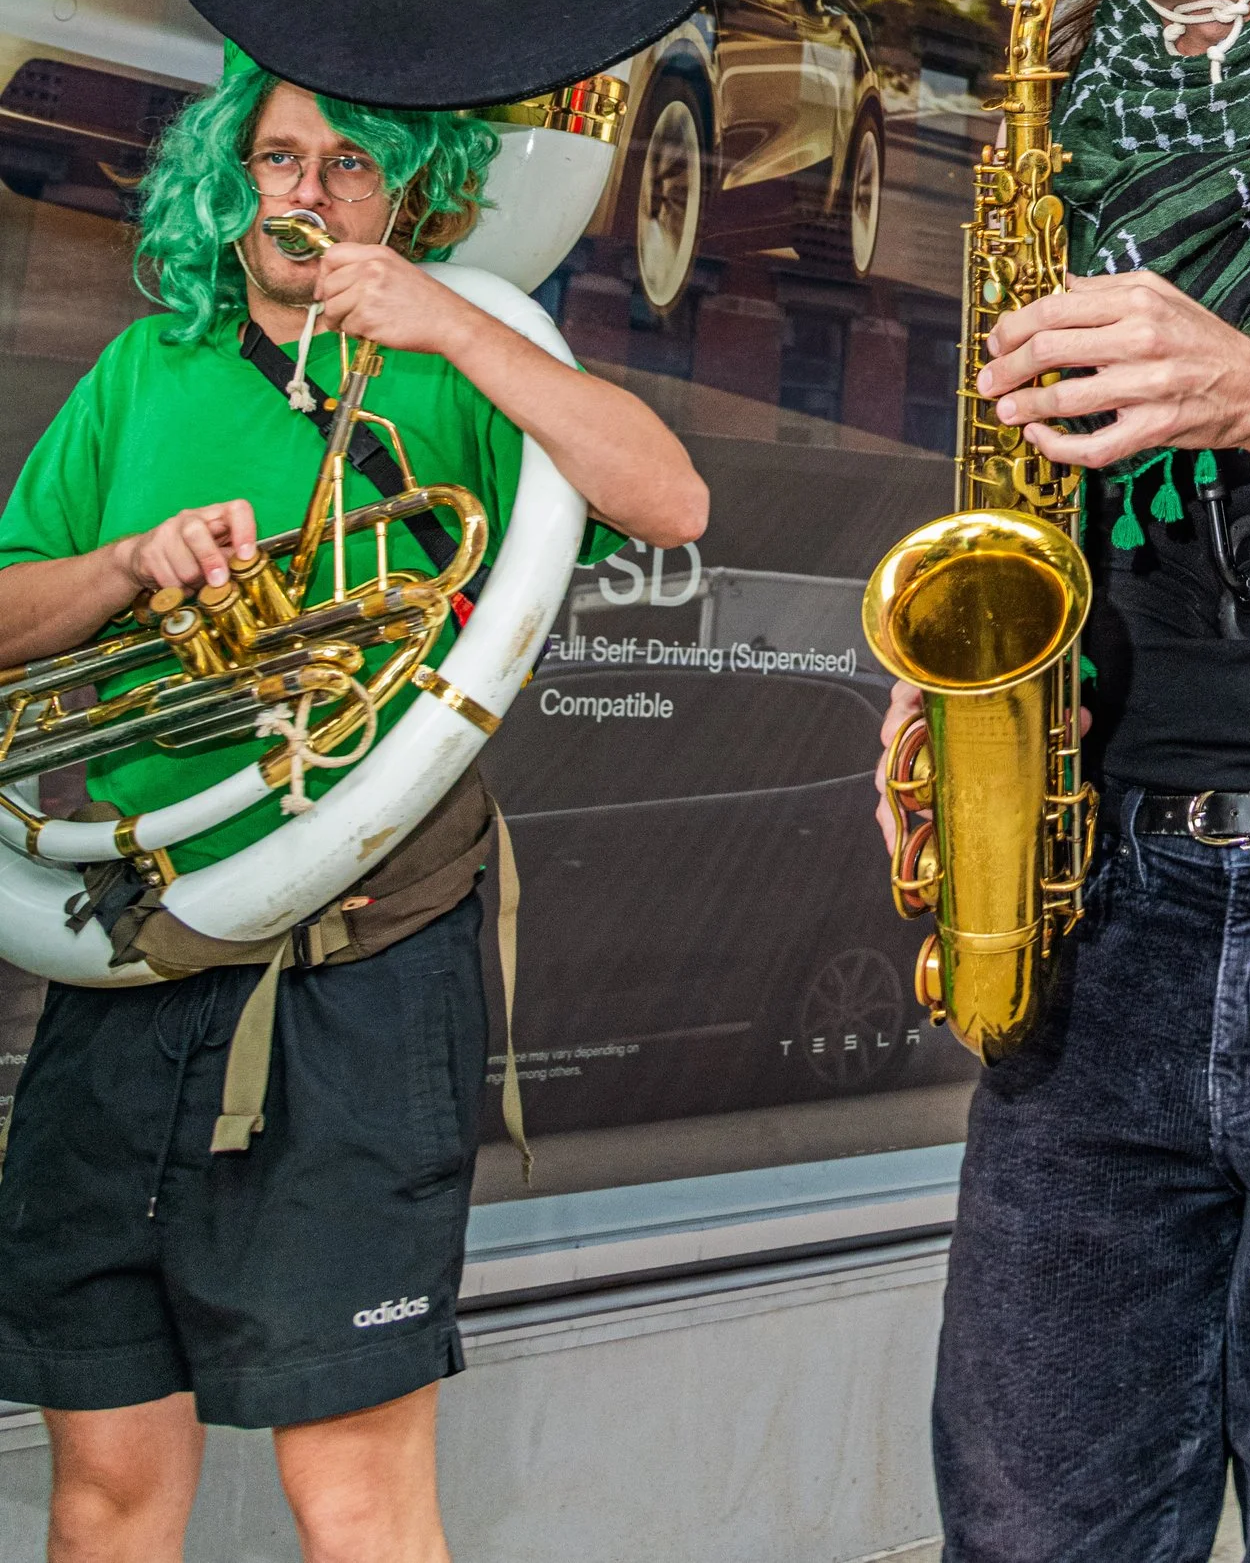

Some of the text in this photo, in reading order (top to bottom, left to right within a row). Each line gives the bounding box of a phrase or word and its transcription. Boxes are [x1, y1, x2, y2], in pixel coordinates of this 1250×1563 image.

[575, 536, 702, 607] SD
[592, 636, 723, 673] Self-Driving
[730, 642, 857, 676] (Supervised)
[540, 689, 674, 722] Compatible
[574, 1043, 625, 1058] depending
[626, 1043, 640, 1054] on
[780, 1029, 920, 1056] TESLA
[517, 1068, 547, 1082] mong
[353, 1296, 430, 1327] adidas
